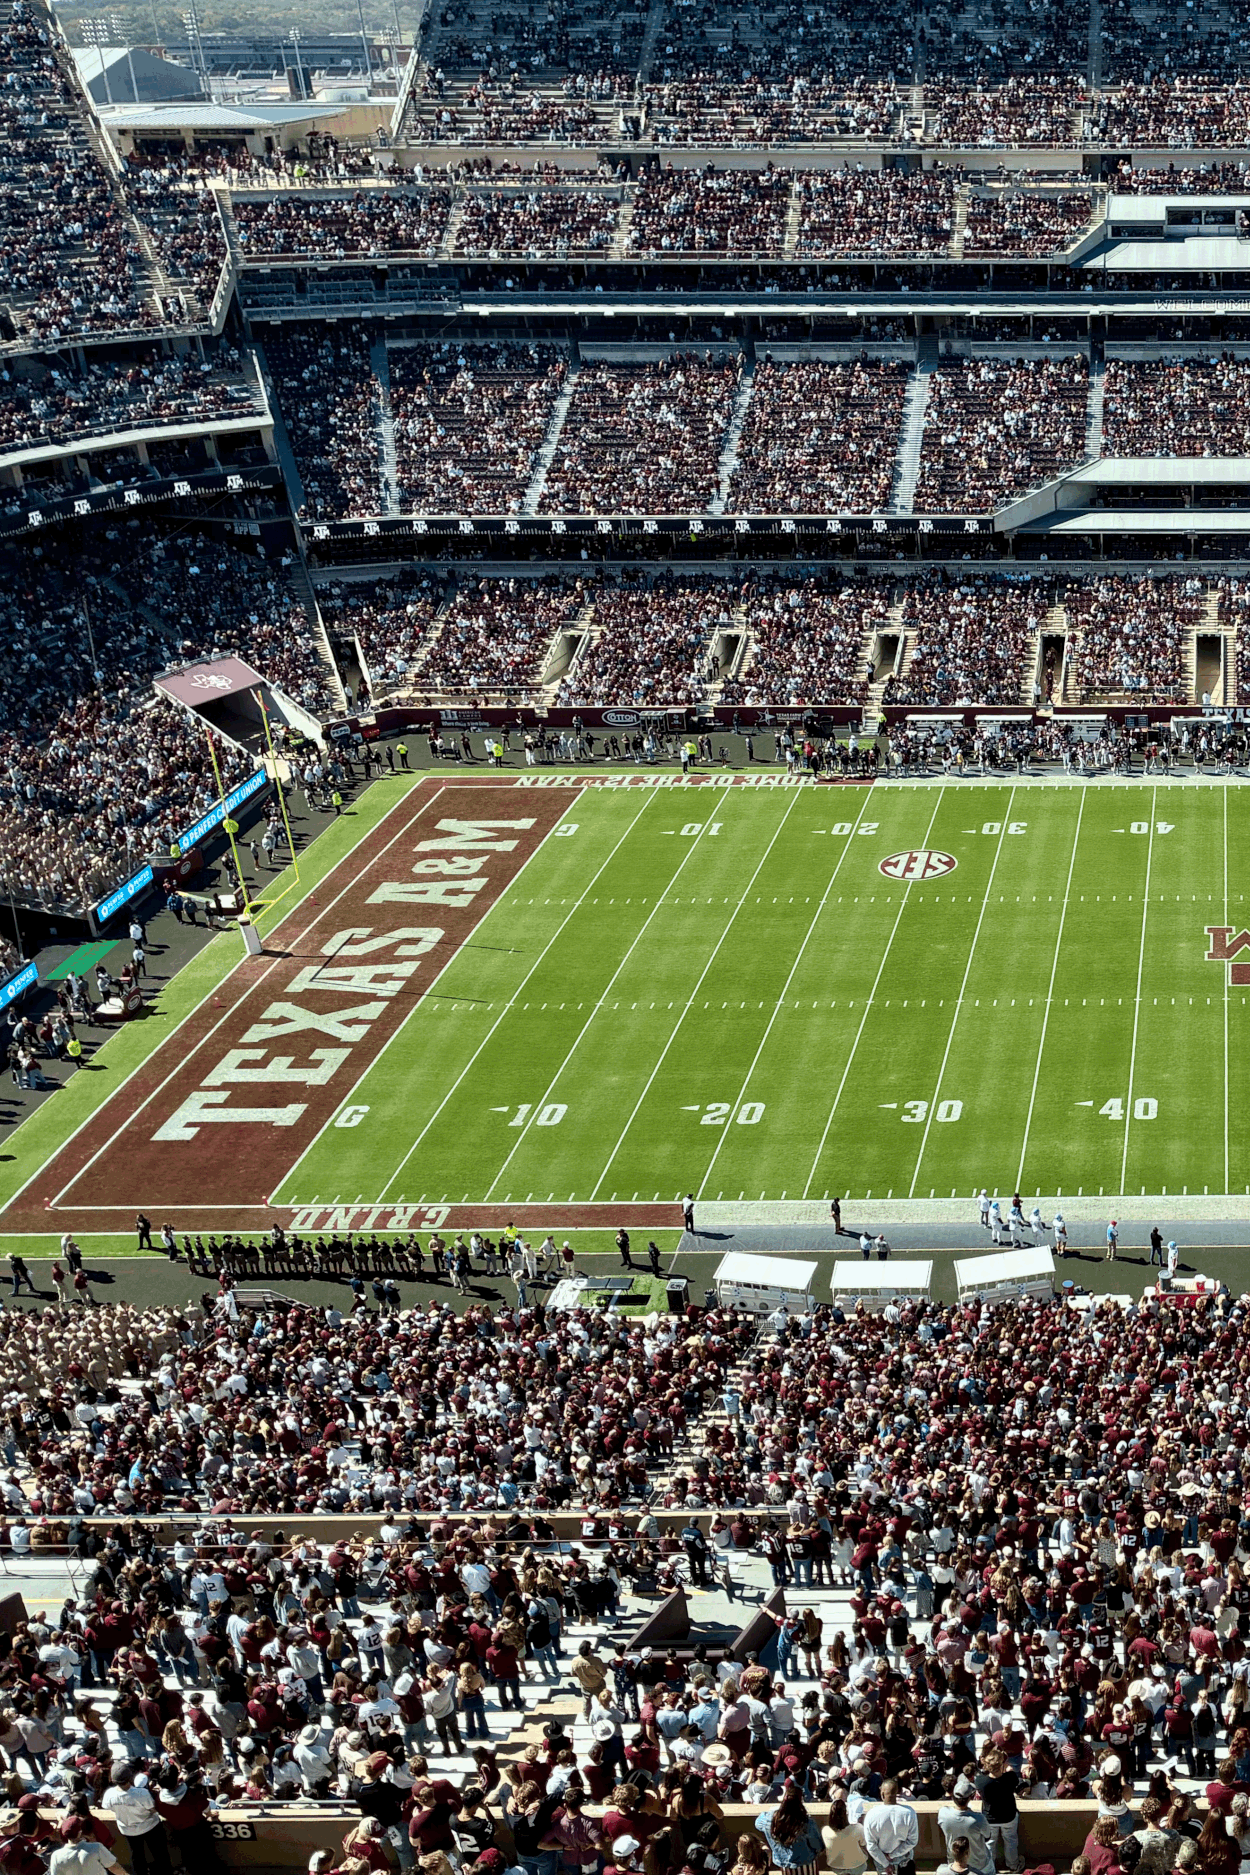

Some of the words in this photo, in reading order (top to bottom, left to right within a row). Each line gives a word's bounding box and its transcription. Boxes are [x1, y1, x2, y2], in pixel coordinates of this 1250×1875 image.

[513, 776, 577, 787] MAN
[640, 775, 693, 786] THE
[698, 775, 736, 786] OF
[739, 774, 818, 786] HOME
[189, 815, 217, 843] PENFED
[241, 776, 263, 800] UNION
[555, 823, 580, 836] G
[679, 822, 724, 836] 10
[831, 821, 881, 836] 20
[981, 821, 1027, 835] 30
[1130, 821, 1176, 835] 40
[884, 851, 953, 878] SEC
[150, 927, 445, 1141] TEXAS
[364, 818, 538, 908] A&M
[334, 1105, 370, 1128] G
[507, 1103, 569, 1127] 10
[700, 1102, 766, 1125] 20
[901, 1100, 964, 1123] 30
[1099, 1098, 1159, 1121] 40
[38, 1412, 51, 1424] 12
[1064, 1495, 1075, 1507] 12
[1111, 1499, 1123, 1511] 12
[582, 1522, 596, 1537] 12
[204, 1582, 217, 1592] 12
[250, 1583, 267, 1595] 12
[367, 1634, 382, 1647] 12
[1095, 1635, 1109, 1648] 12
[1133, 1723, 1146, 1736] 12
[211, 1822, 252, 1840] 336
